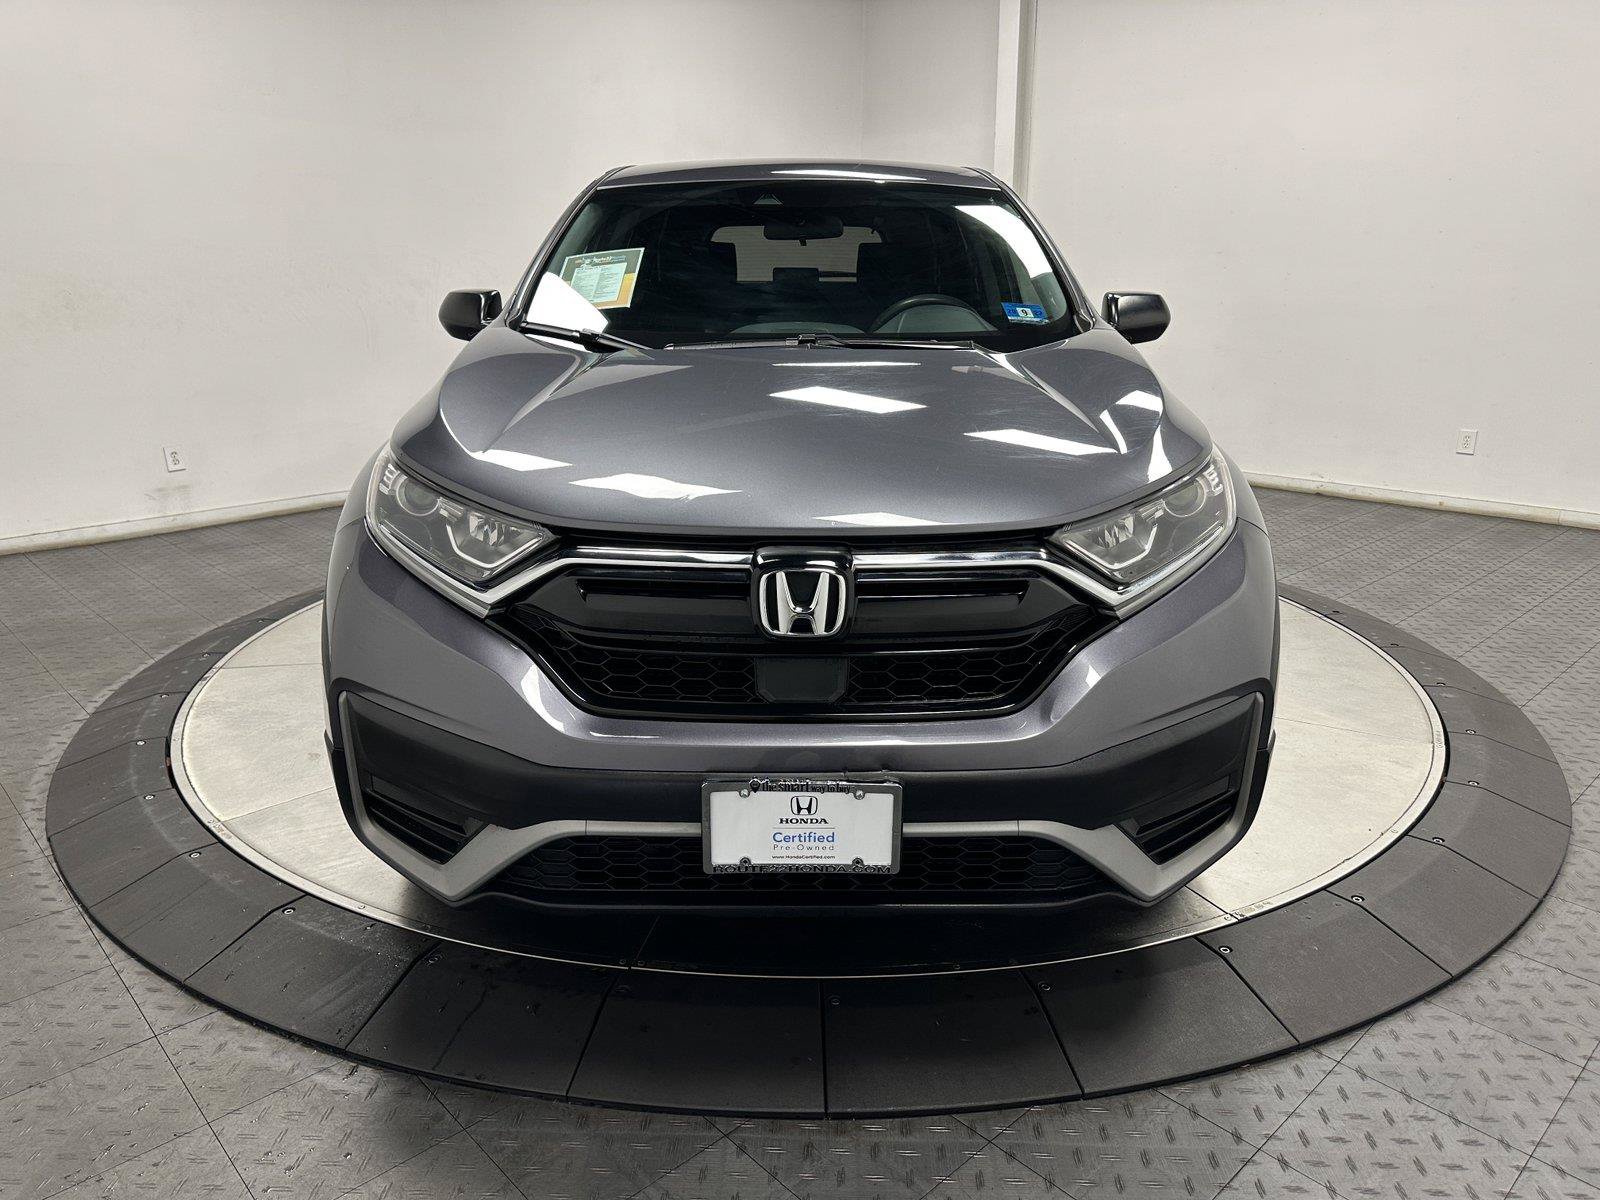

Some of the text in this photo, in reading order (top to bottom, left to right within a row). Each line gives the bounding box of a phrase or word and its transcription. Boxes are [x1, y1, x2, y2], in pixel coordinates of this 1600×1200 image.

[778, 781, 812, 793] smart
[812, 785, 825, 794] way
[827, 783, 835, 792] to
[836, 782, 851, 795] buy
[772, 831, 836, 843] Certified
[773, 843, 835, 851] Pre-Owned
